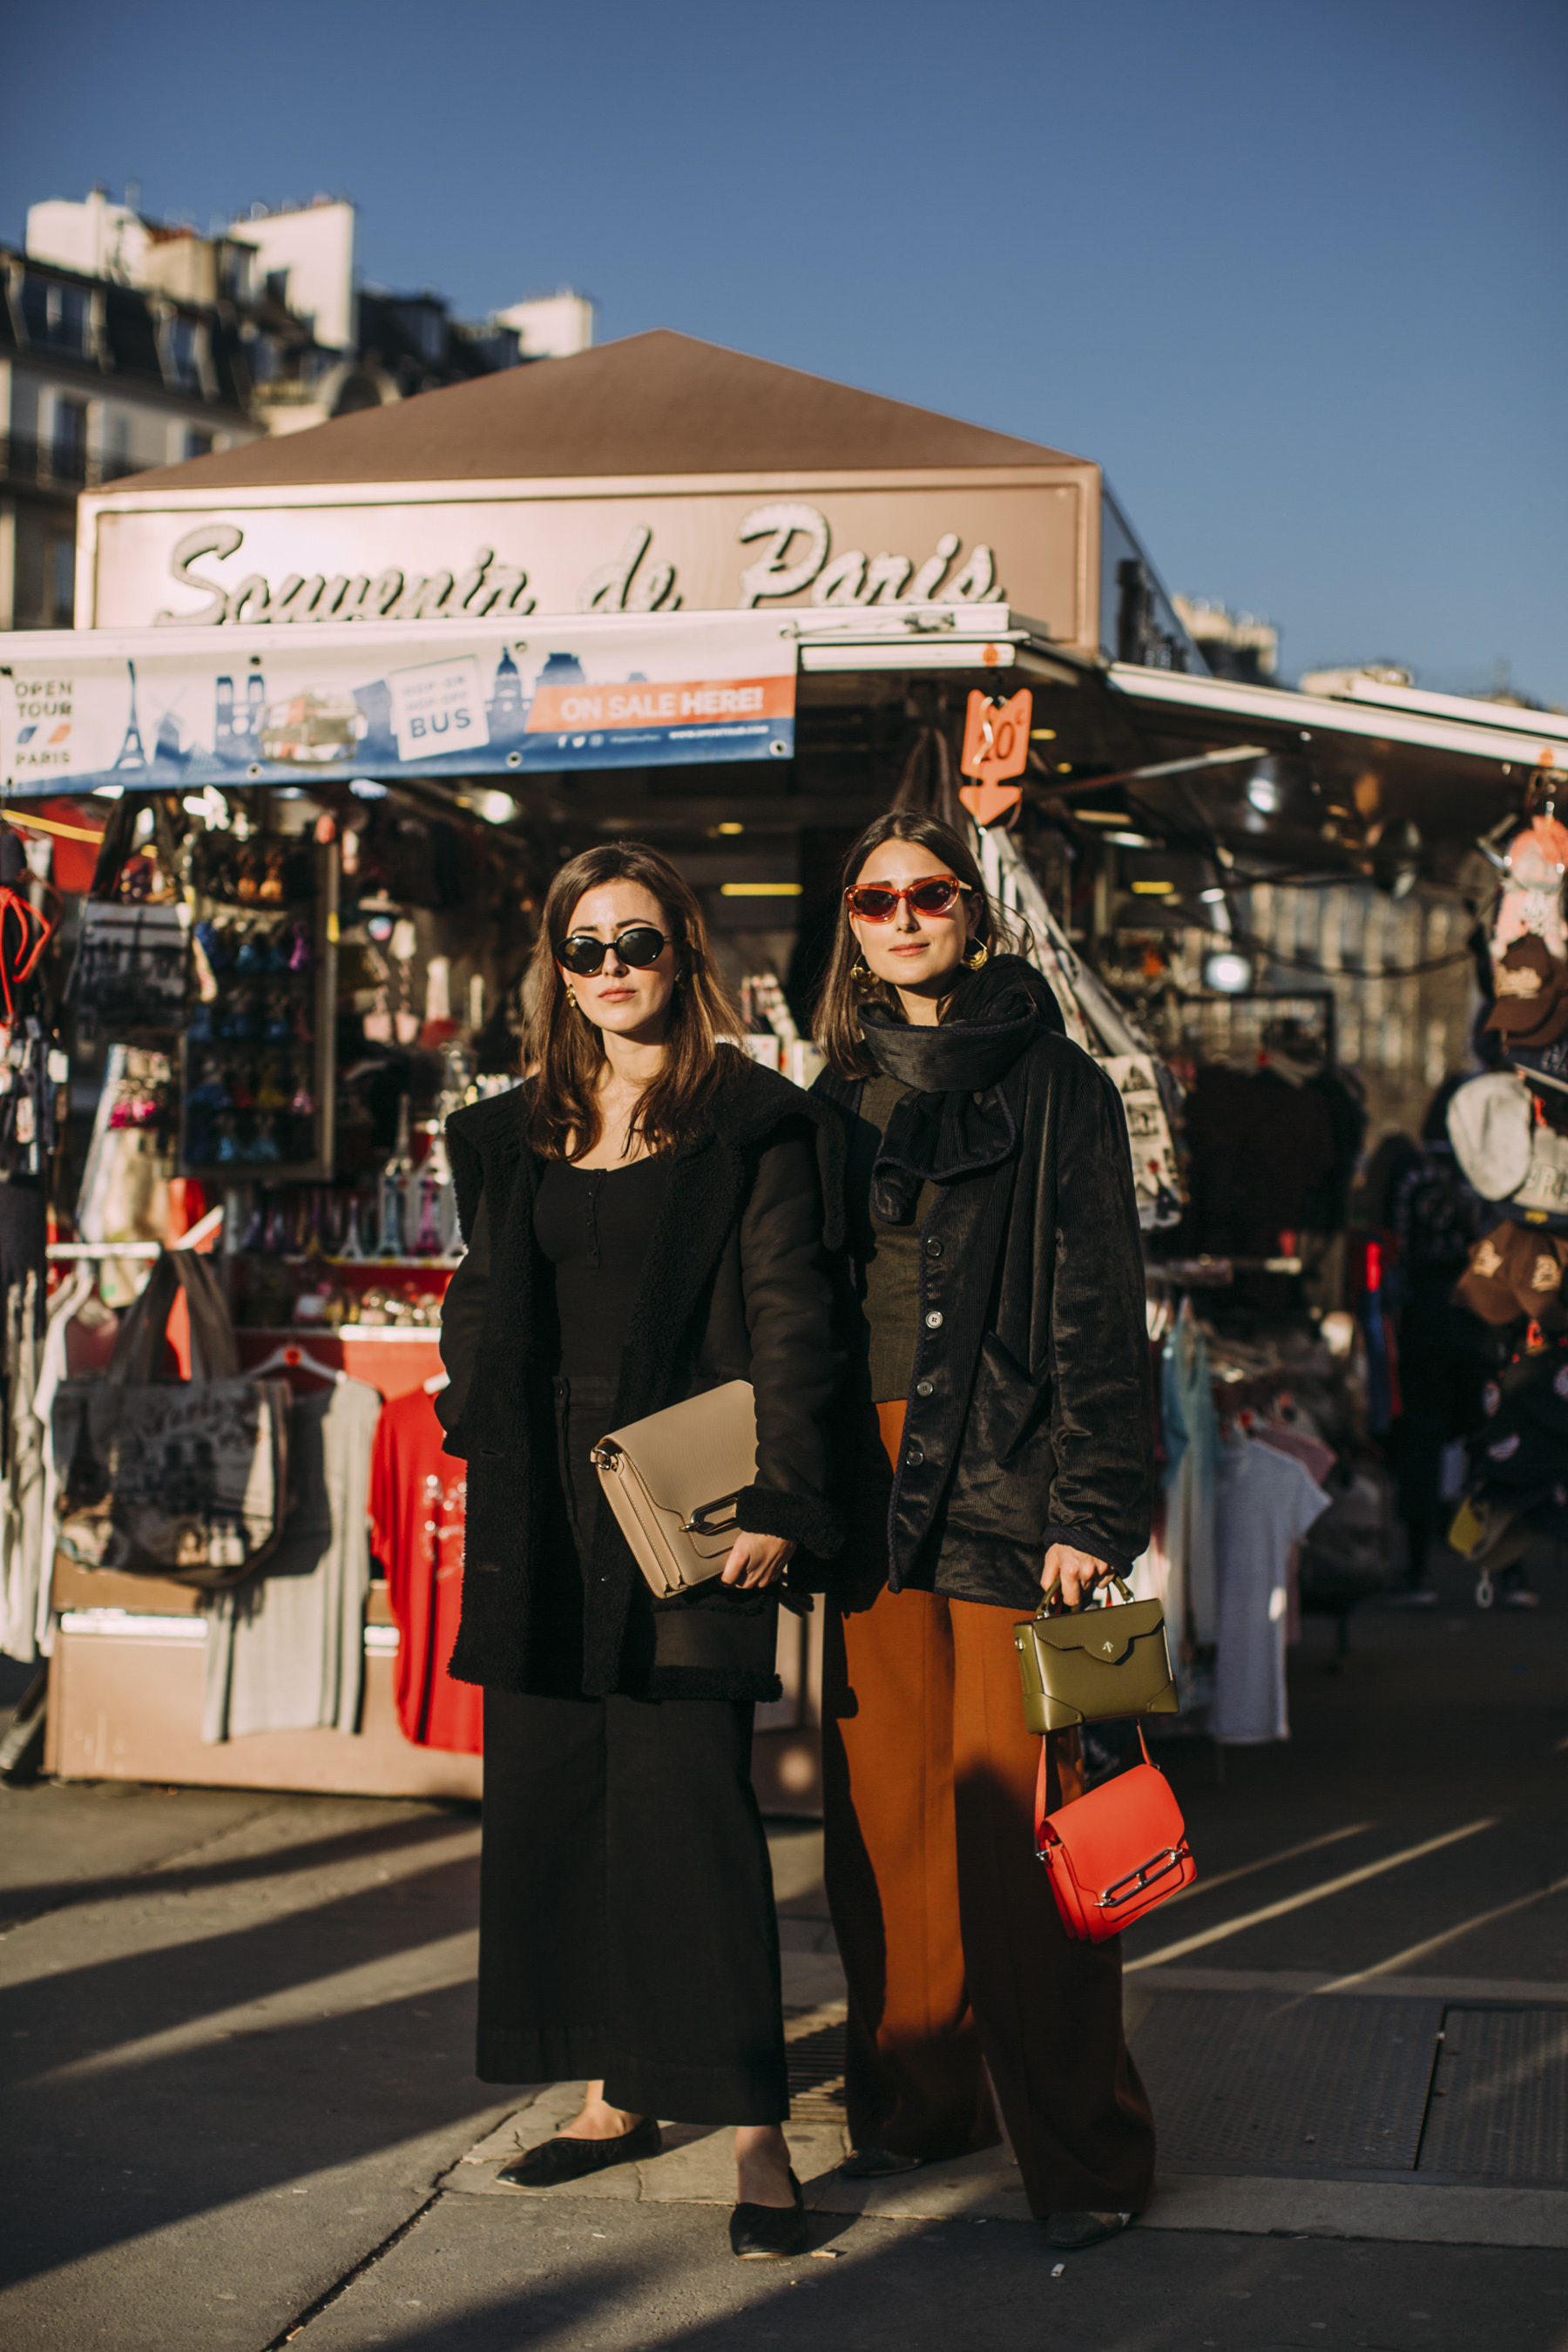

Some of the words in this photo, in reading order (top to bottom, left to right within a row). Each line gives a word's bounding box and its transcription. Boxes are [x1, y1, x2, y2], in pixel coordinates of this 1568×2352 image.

[152, 524, 537, 626] Souvenir
[577, 524, 684, 614] de
[735, 502, 1008, 608] Paris
[15, 681, 73, 698] OPEN
[17, 700, 71, 719] TOUR
[560, 698, 603, 722] ON
[606, 693, 677, 719] SALE
[679, 686, 765, 716] HERE!
[409, 707, 472, 740] BUS
[15, 751, 71, 767] PARIS
